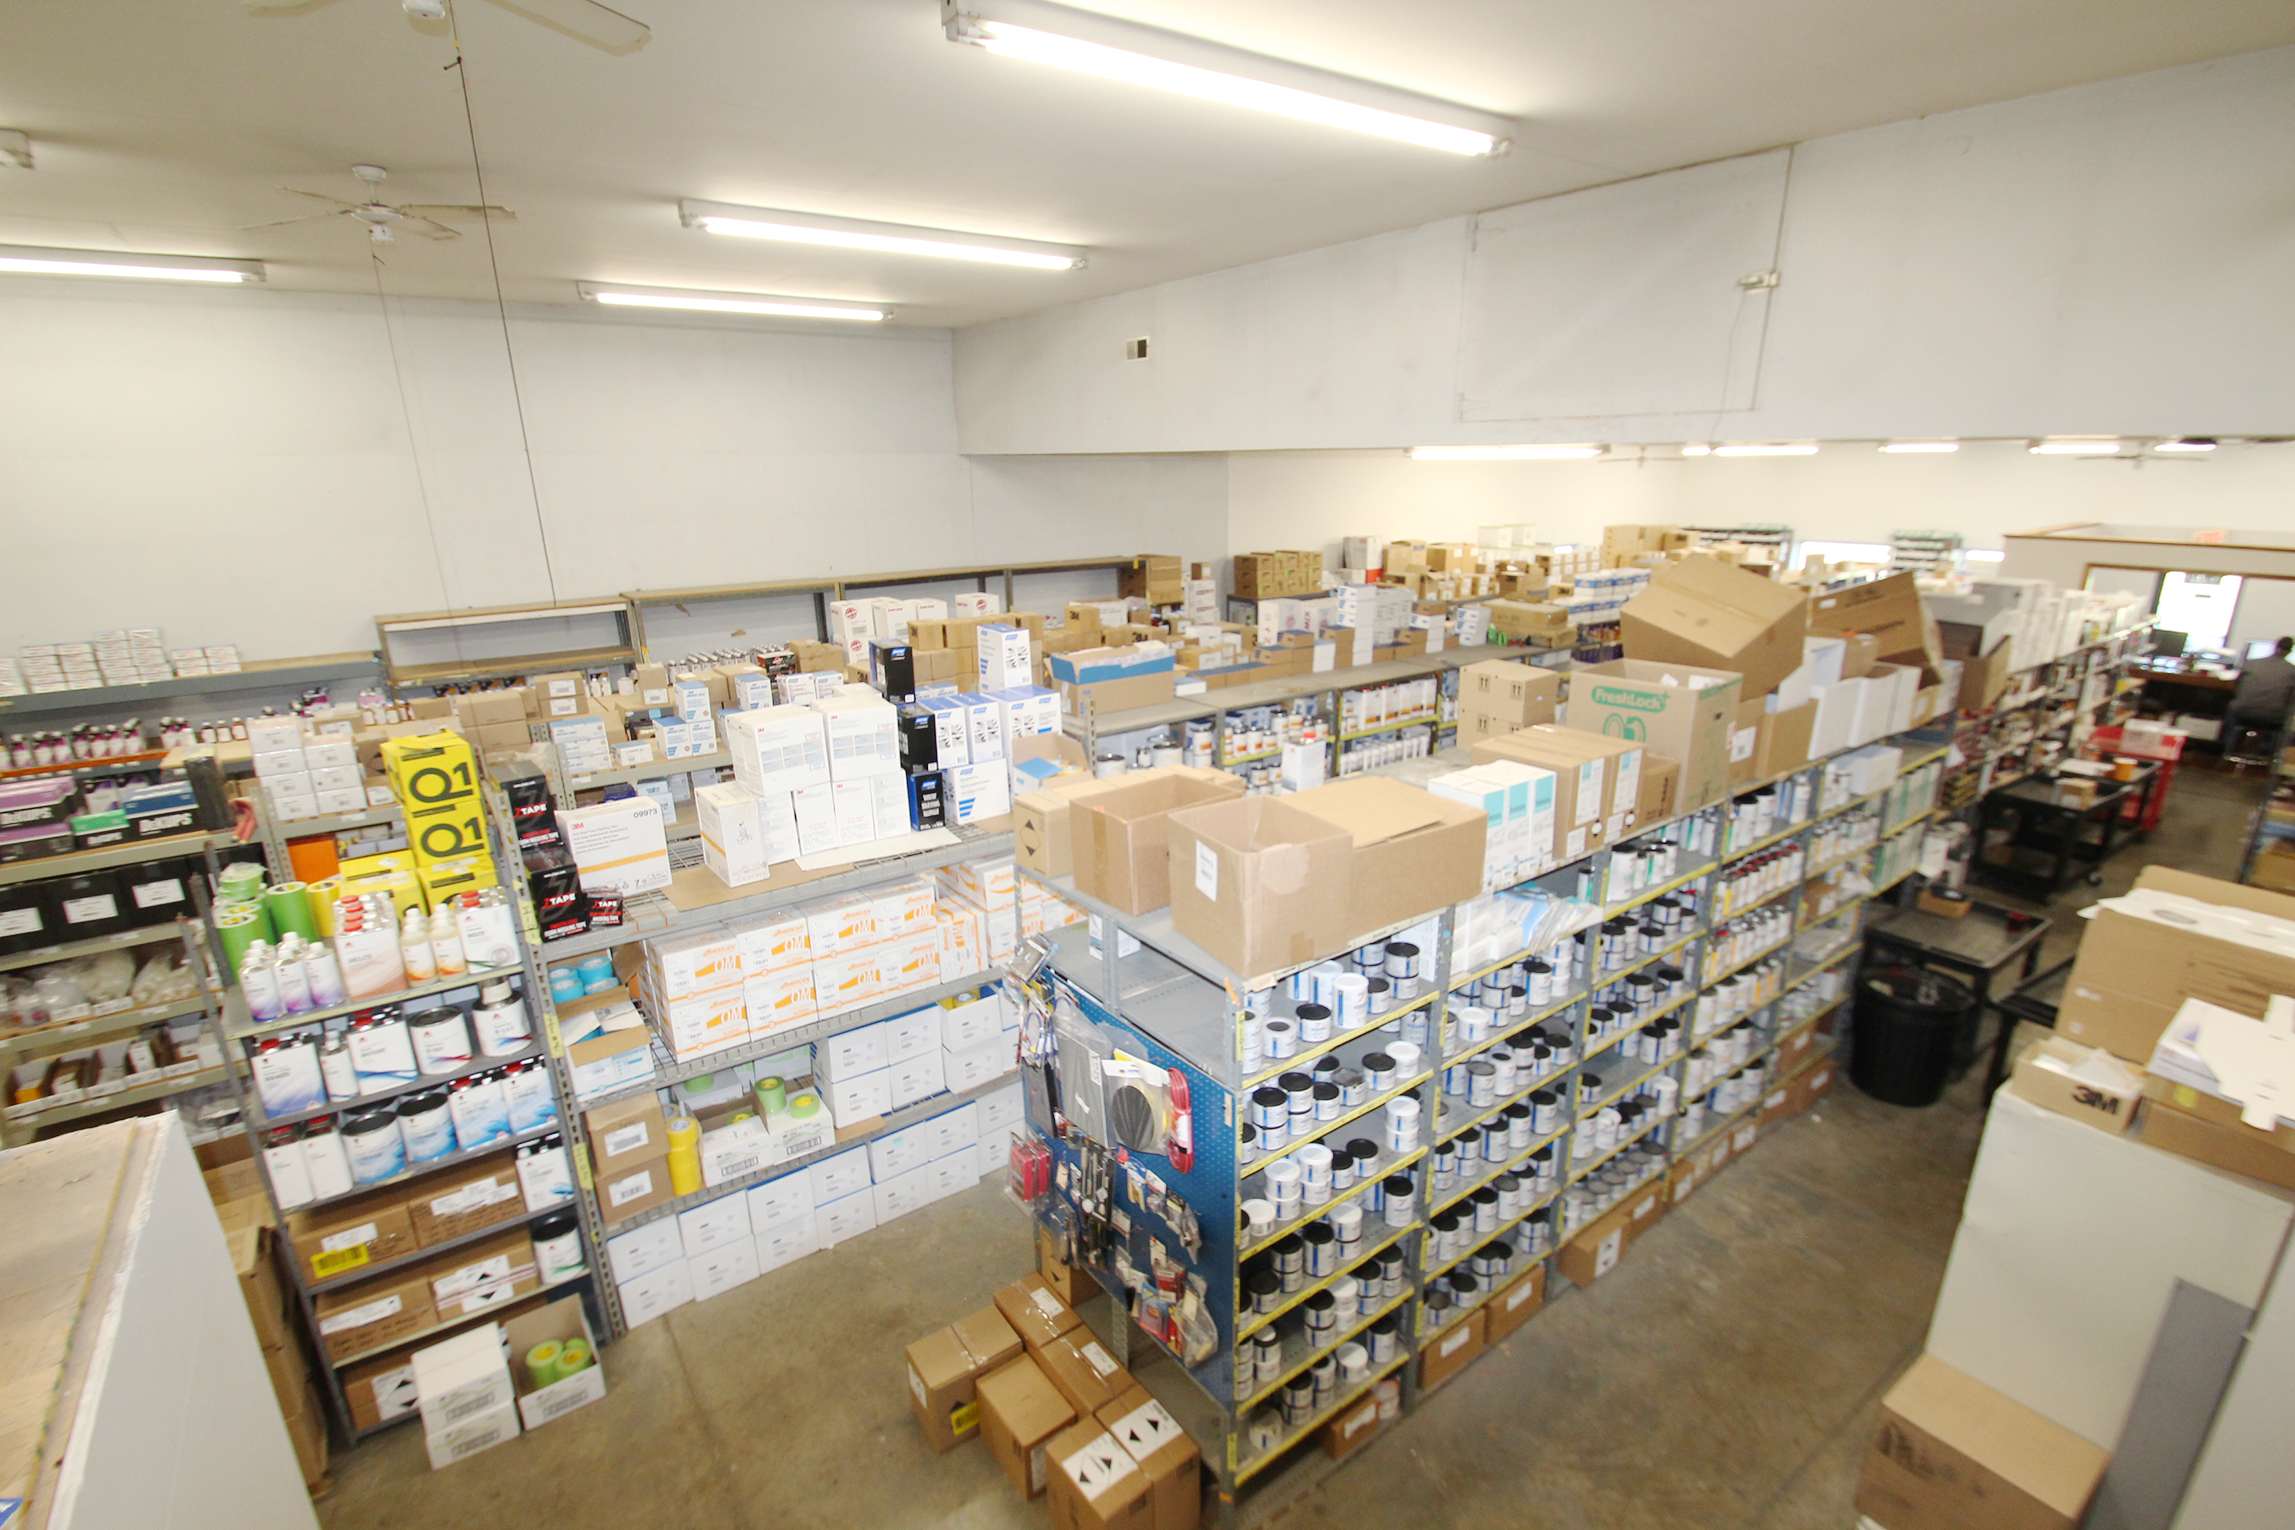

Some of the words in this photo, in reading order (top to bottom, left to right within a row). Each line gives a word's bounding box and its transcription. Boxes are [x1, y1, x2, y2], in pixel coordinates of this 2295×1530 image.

[409, 762, 473, 803] Q1
[633, 808, 658, 819] 09973
[421, 817, 485, 857] Q1
[905, 894, 932, 904] AMERICAN
[843, 908, 872, 920] AMERICAN
[773, 925, 804, 937] AMERICAN
[852, 919, 872, 934] OM
[702, 944, 736, 957] AMERICAN
[784, 936, 805, 951] OM
[910, 943, 936, 954] AMERICAN
[714, 955, 737, 972] OM
[848, 959, 876, 971] AMERICAN
[780, 976, 810, 989] AMERICAN
[857, 970, 877, 985] OM
[791, 987, 812, 1002] OM
[710, 995, 741, 1009] AMERICAN
[721, 1007, 743, 1022] OM
[2071, 1085, 2119, 1116] 3M
